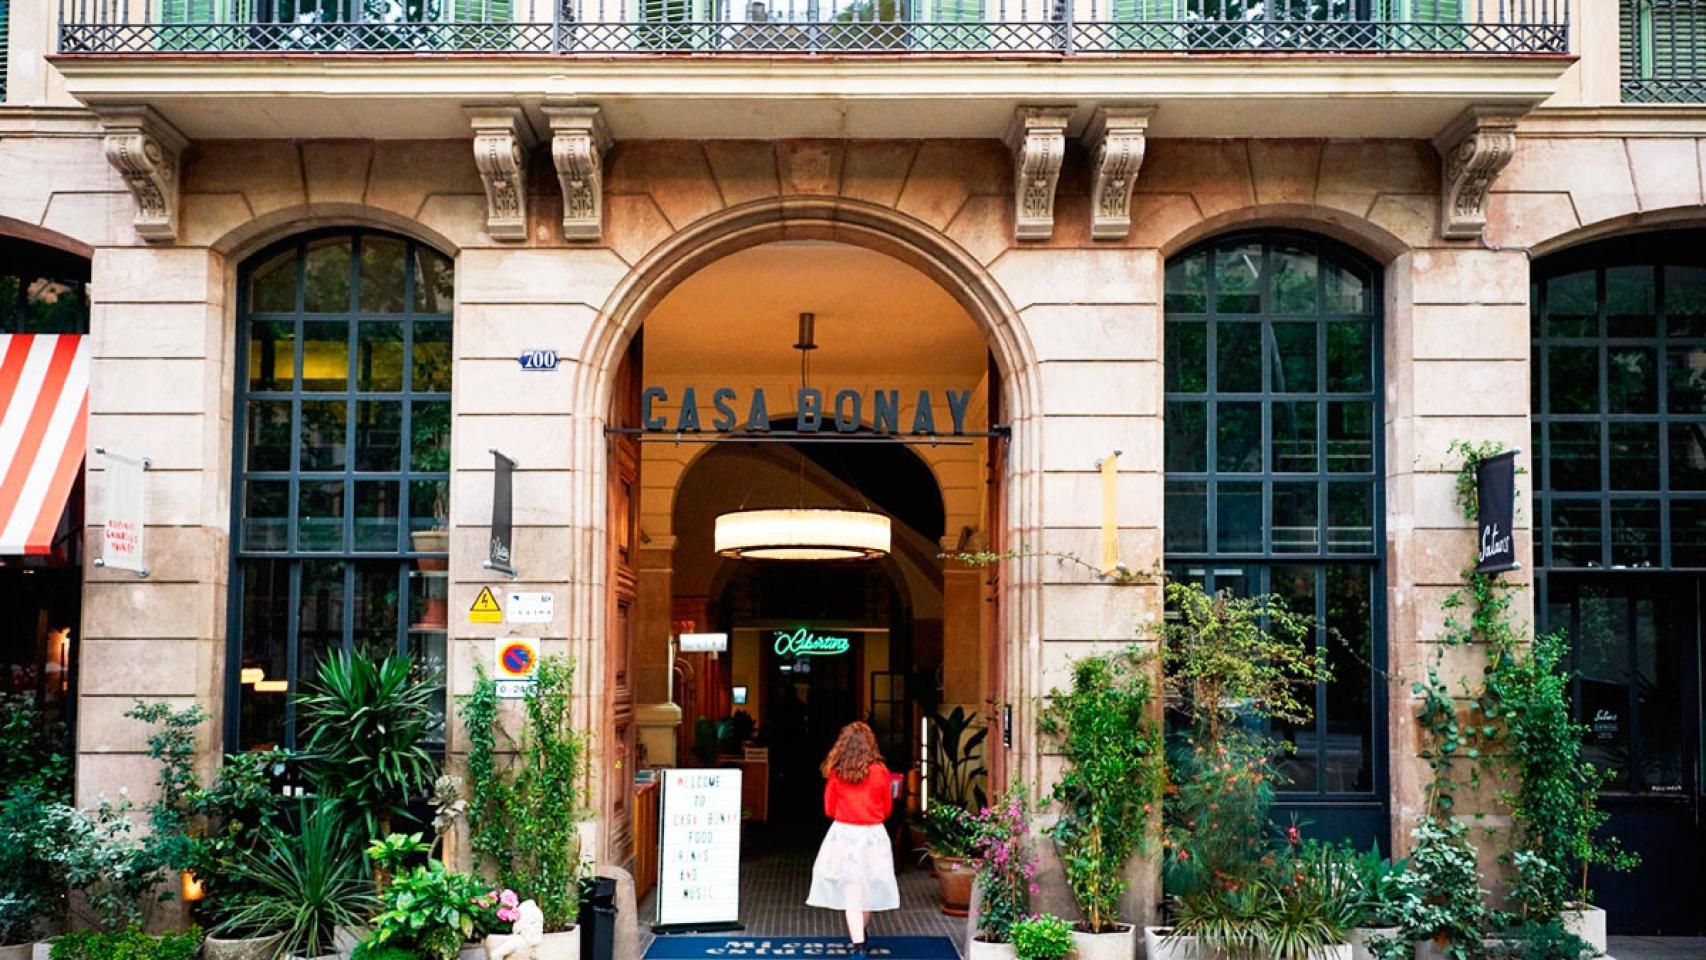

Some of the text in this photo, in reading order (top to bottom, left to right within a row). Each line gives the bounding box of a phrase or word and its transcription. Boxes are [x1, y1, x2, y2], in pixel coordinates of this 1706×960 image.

[525, 351, 555, 368] 700
[642, 386, 970, 434] CASA BONAY
[694, 795, 706, 807] TO
[688, 832, 713, 844] FOOD
